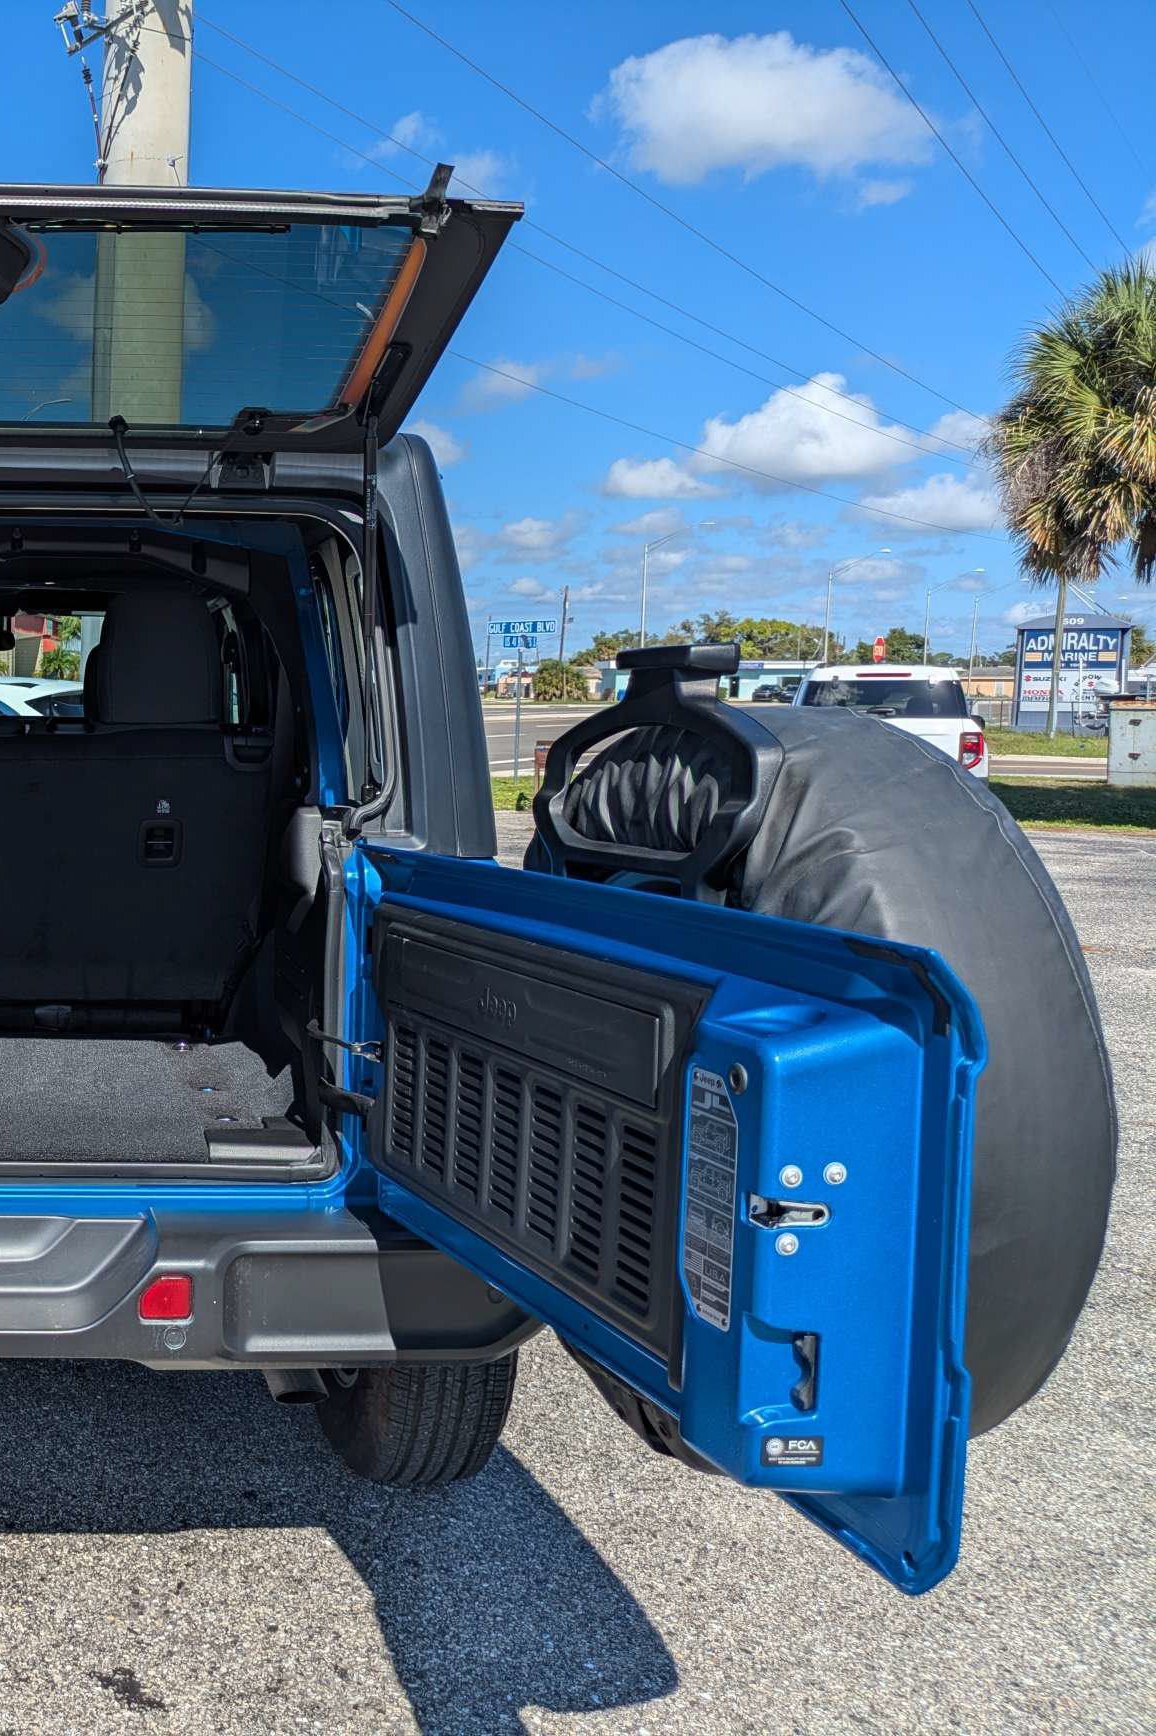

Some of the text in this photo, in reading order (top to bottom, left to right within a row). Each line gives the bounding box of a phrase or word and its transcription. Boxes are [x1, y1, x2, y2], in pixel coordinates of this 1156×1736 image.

[489, 621, 555, 633] GULF COAST BLVD
[1043, 652, 1097, 661] MRINE
[788, 1440, 817, 1450] FCA
